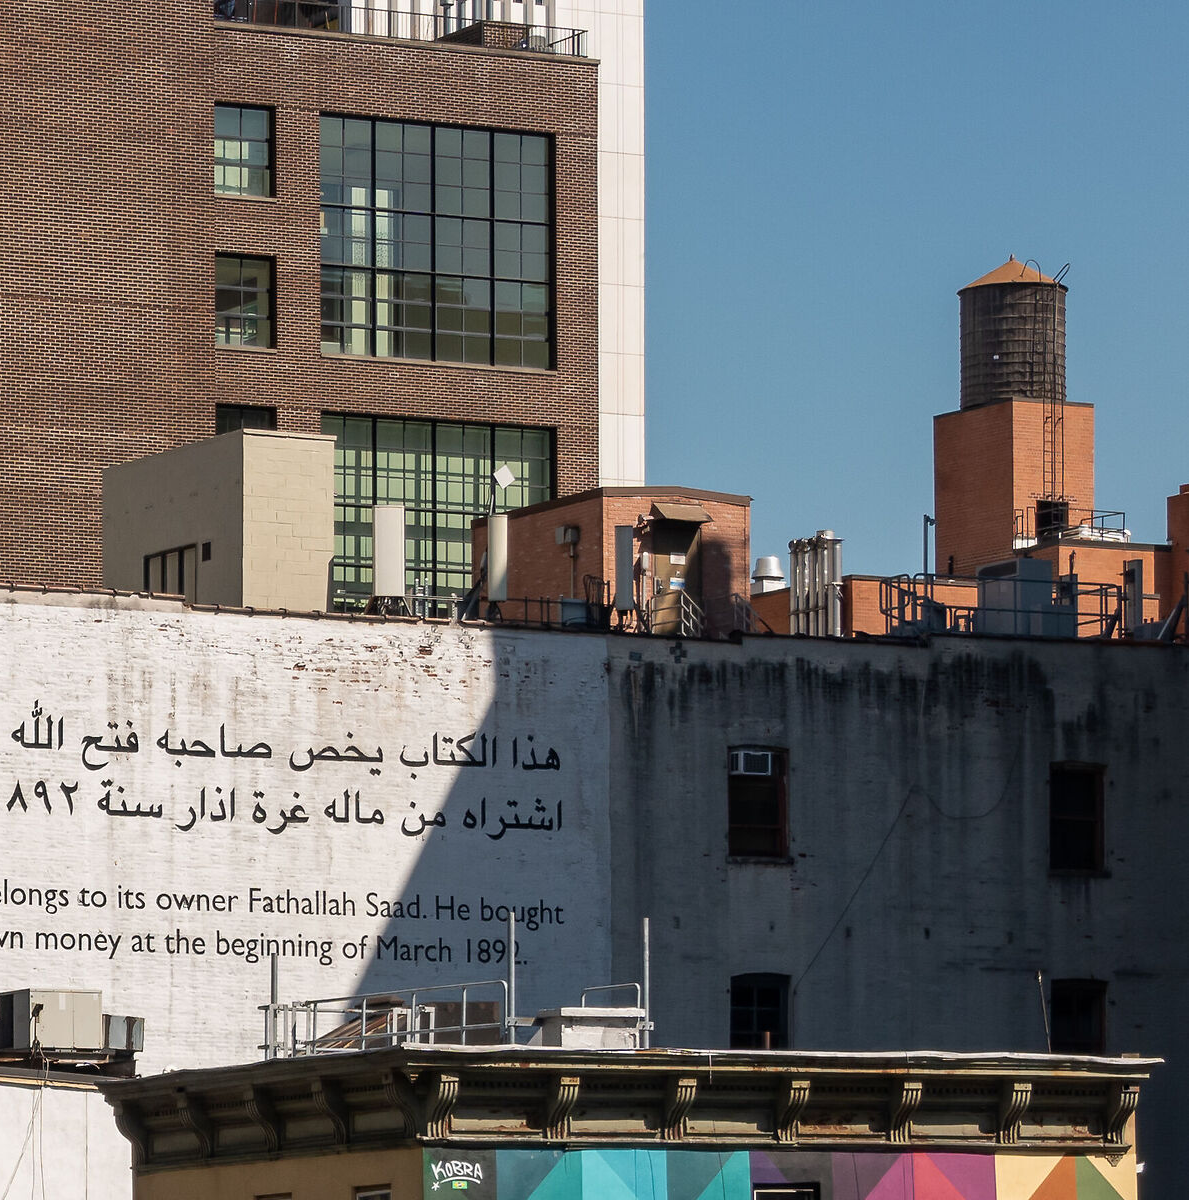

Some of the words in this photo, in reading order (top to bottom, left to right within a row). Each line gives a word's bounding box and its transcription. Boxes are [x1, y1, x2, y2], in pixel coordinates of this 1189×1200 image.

[80, 719, 140, 771] فتح
[156, 723, 273, 768] صاحبه
[289, 731, 384, 776] يخص
[399, 731, 498, 780] الكتاب
[512, 733, 561, 771] هذا
[97, 778, 163, 818] سنة
[175, 786, 236, 832] اذار
[252, 790, 310, 835] غرة
[323, 788, 385, 826] ماله
[400, 800, 447, 837] من
[461, 796, 563, 841] اشتراه
[77, 887, 107, 908] to
[117, 884, 146, 910] its
[155, 893, 239, 913] owner
[249, 887, 356, 917] Fathallah
[366, 892, 427, 920] Saad.
[435, 895, 470, 921] He
[480, 896, 565, 932] bought
[35, 931, 122, 960] money
[131, 933, 156, 953] at
[164, 928, 206, 955] the
[216, 929, 333, 966] beginning
[342, 934, 369, 960] of
[376, 936, 452, 963] March
[431, 1160, 483, 1180] KOBRA
